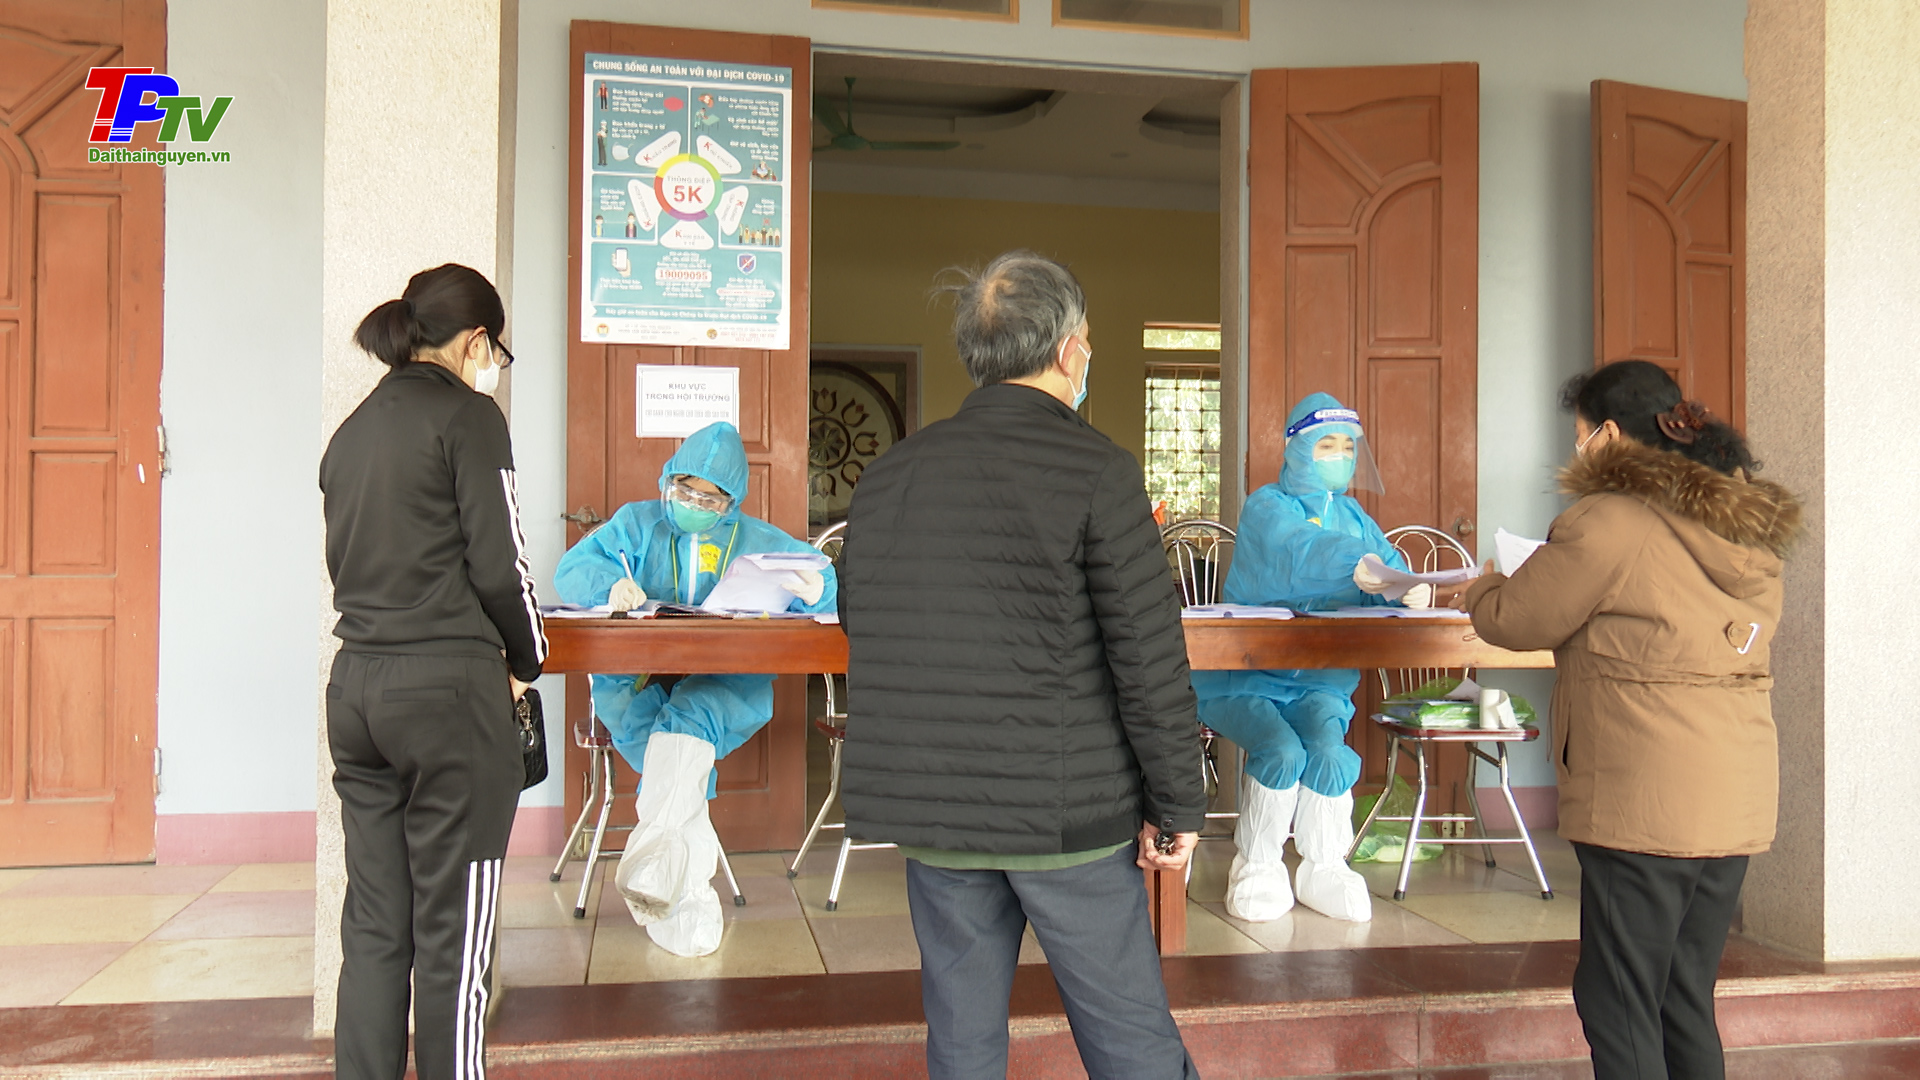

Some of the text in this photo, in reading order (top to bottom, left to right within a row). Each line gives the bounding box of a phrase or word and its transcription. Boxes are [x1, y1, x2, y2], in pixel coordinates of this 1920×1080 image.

[592, 60, 622, 72] CHUNG
[624, 60, 648, 74] SỐNG
[649, 64, 662, 74] AN
[664, 63, 688, 76] TOÀN
[689, 65, 704, 78] VỚI
[746, 71, 785, 84] COVID-19
[674, 185, 704, 204] 5K
[689, 383, 706, 392] VỰC
[677, 393, 691, 402] HỘI
[694, 393, 730, 402] TRƯỜNG
